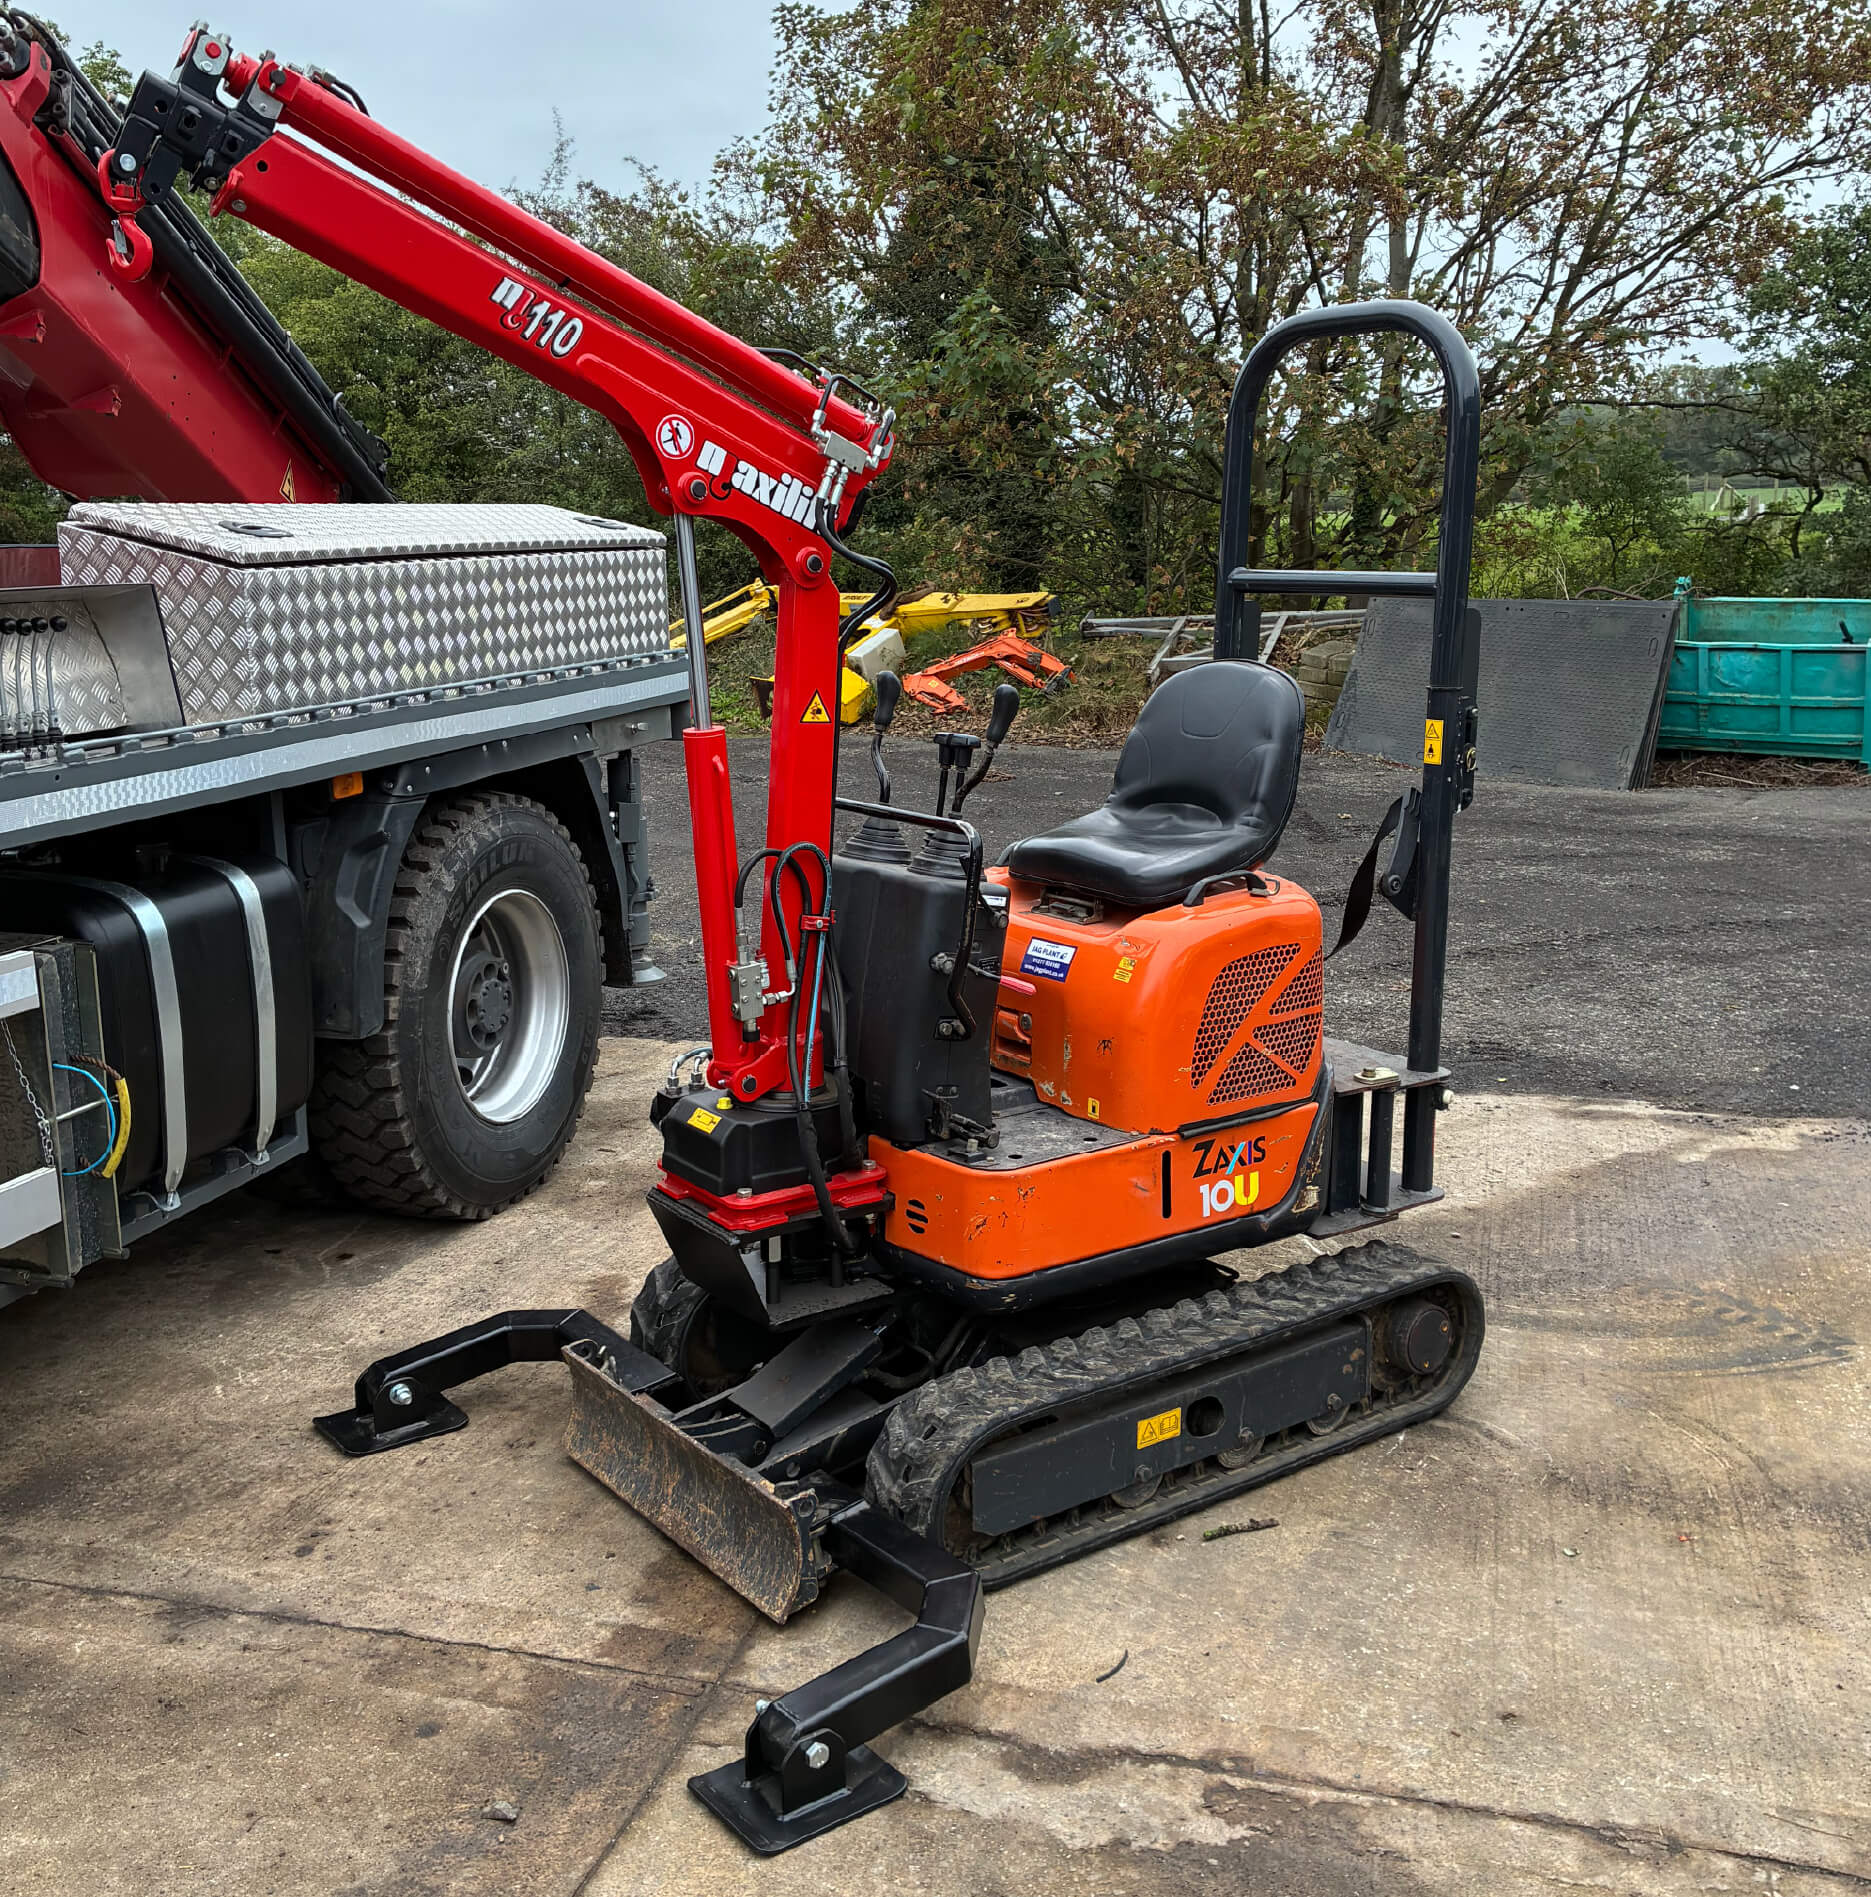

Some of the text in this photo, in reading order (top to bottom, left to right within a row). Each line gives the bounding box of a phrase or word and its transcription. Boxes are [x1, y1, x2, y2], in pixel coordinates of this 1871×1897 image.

[1042, 948, 1061, 958] PLANT
[1192, 1136, 1266, 1178] ZAXIS
[1199, 1171, 1260, 1218] 10U
